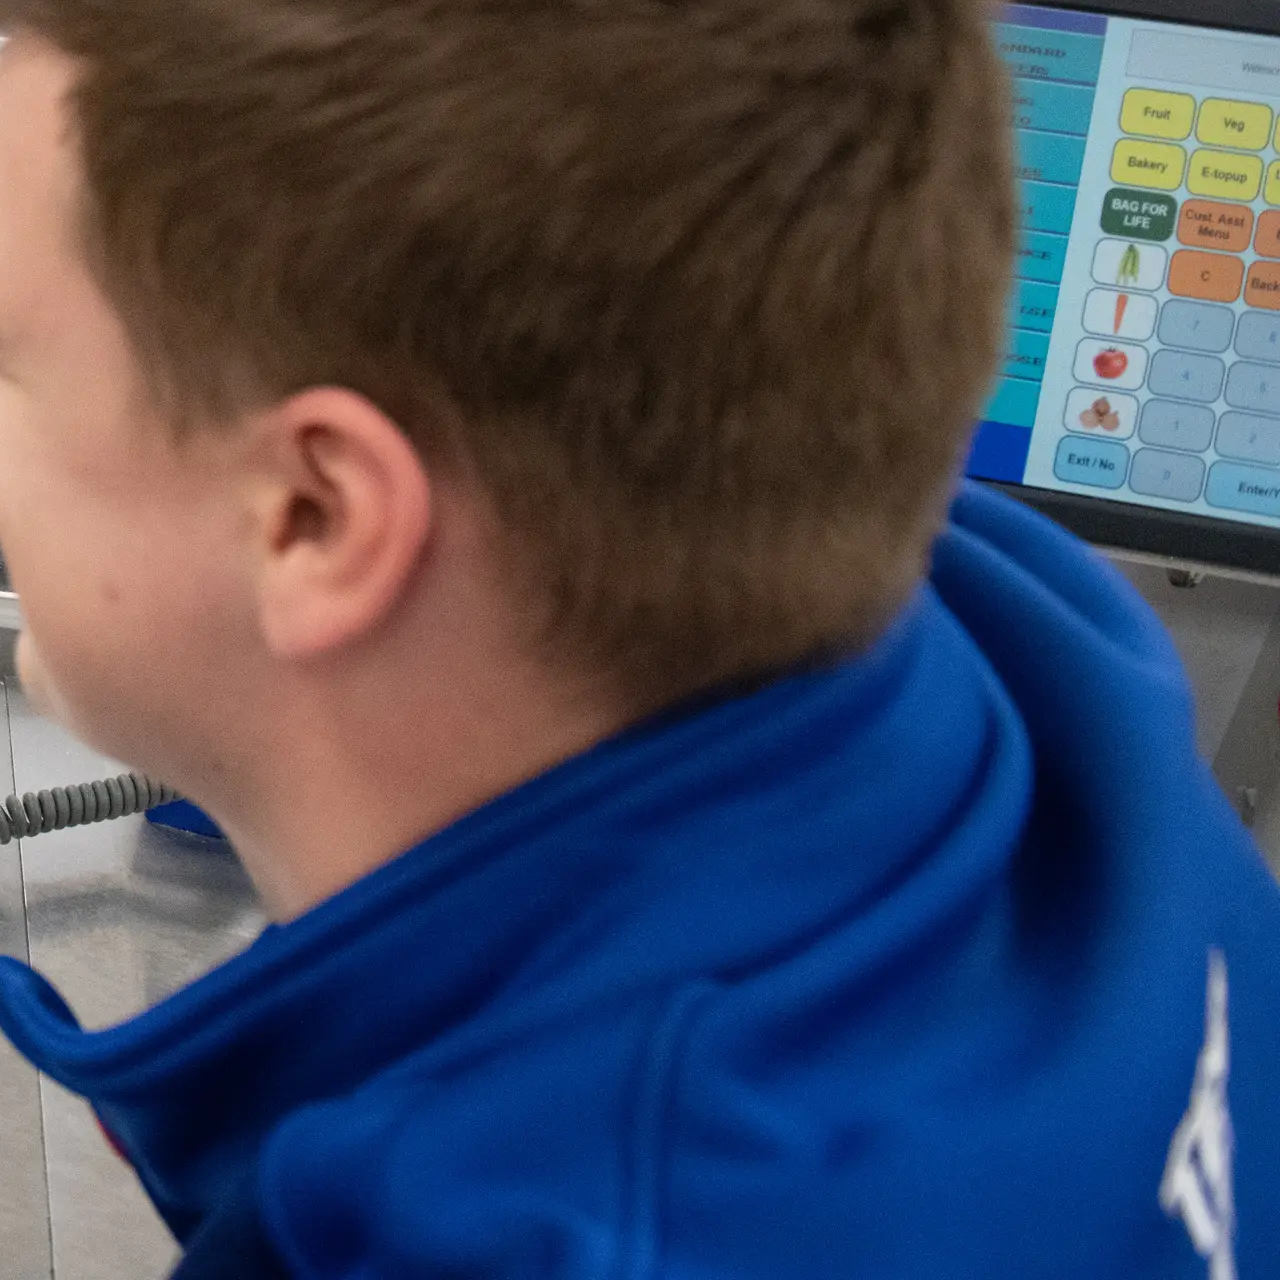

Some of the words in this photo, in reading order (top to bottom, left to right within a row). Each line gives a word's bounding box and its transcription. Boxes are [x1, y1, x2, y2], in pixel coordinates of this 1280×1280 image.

[1144, 107, 1171, 121] Fruit
[1224, 118, 1246, 133] Veg
[1127, 156, 1169, 174] Bakery
[1201, 167, 1248, 184] E-topup
[1112, 198, 1140, 213] BAG
[1141, 202, 1169, 217] FOR
[1123, 216, 1151, 230] LIFE
[1185, 209, 1215, 224] Cust.
[1217, 213, 1246, 228] Asst
[1197, 225, 1231, 240] Menu
[1200, 270, 1211, 282] C
[1067, 453, 1092, 467] Exit
[1098, 459, 1116, 472] No
